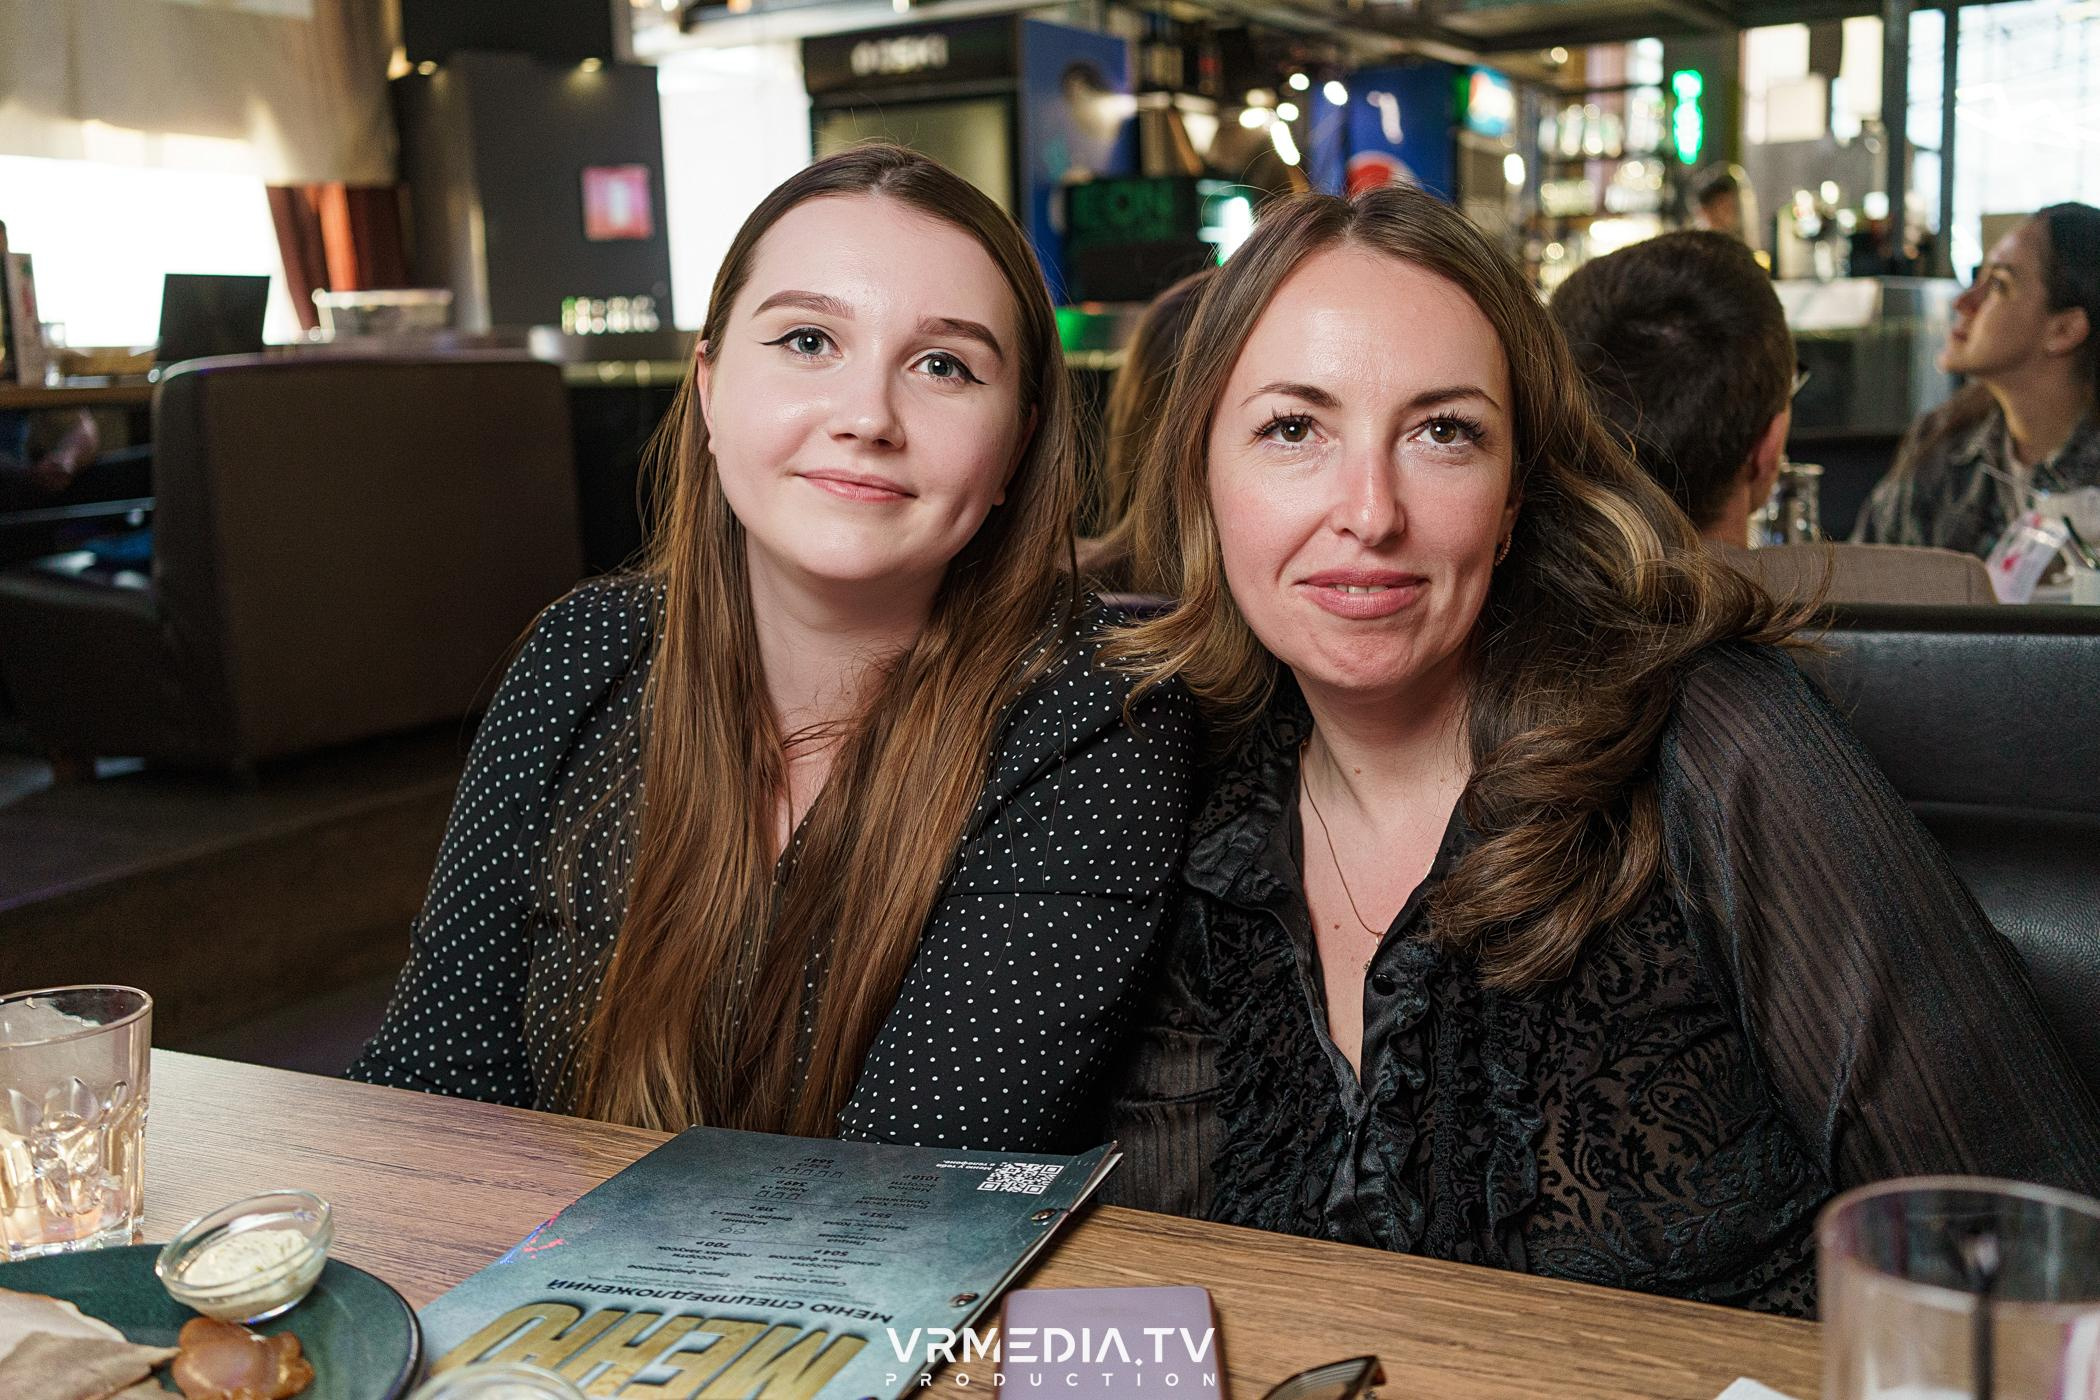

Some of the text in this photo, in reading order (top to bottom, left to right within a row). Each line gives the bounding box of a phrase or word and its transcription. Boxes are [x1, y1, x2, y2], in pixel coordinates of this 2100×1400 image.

[673, 1253, 719, 1261] Ассорти
[792, 1262, 841, 1270] Ассорти
[546, 1278, 805, 1309] СПЕЦПРЕДЛОЖЕНИЙ
[810, 1303, 894, 1324] МЕНЮ
[430, 1301, 869, 1400] МЕНЮ
